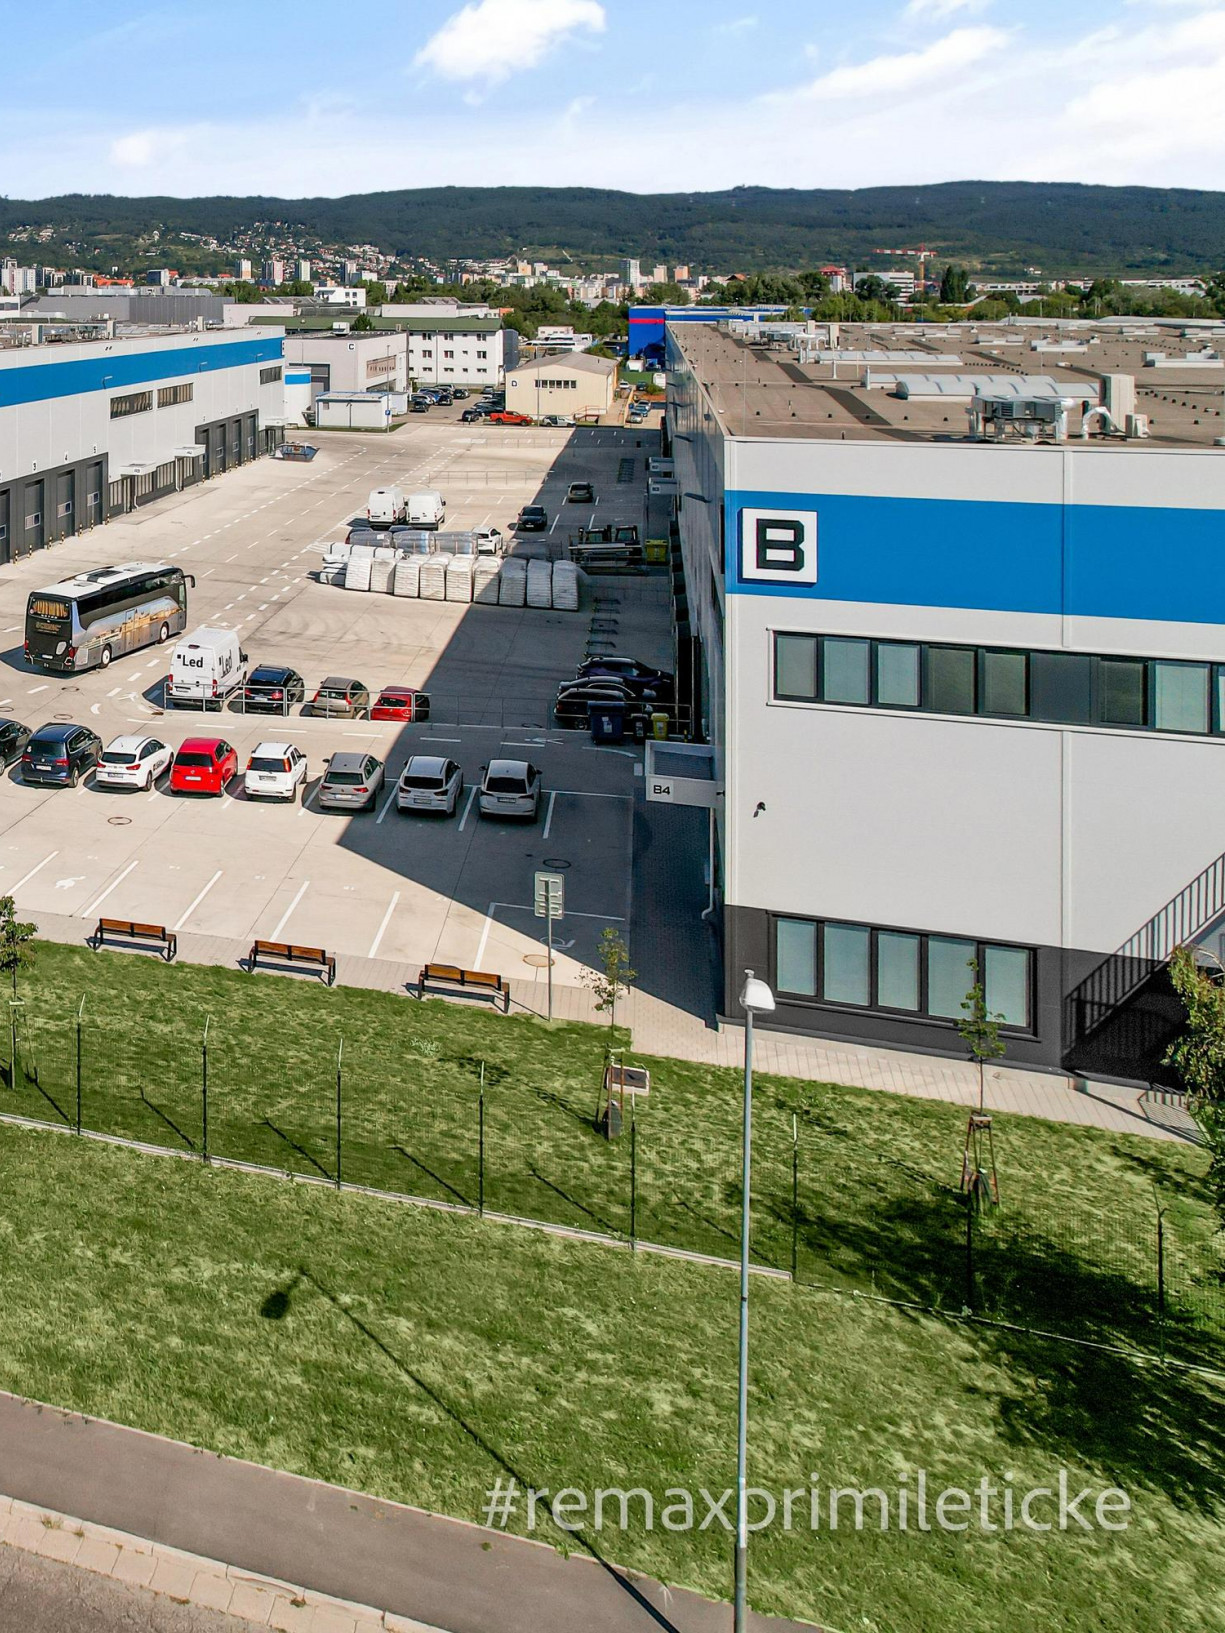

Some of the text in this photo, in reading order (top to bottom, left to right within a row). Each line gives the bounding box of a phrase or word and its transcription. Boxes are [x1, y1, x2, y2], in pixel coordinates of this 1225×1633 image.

[756, 518, 805, 572] B
[182, 654, 204, 668] Led
[653, 784, 671, 795] B4
